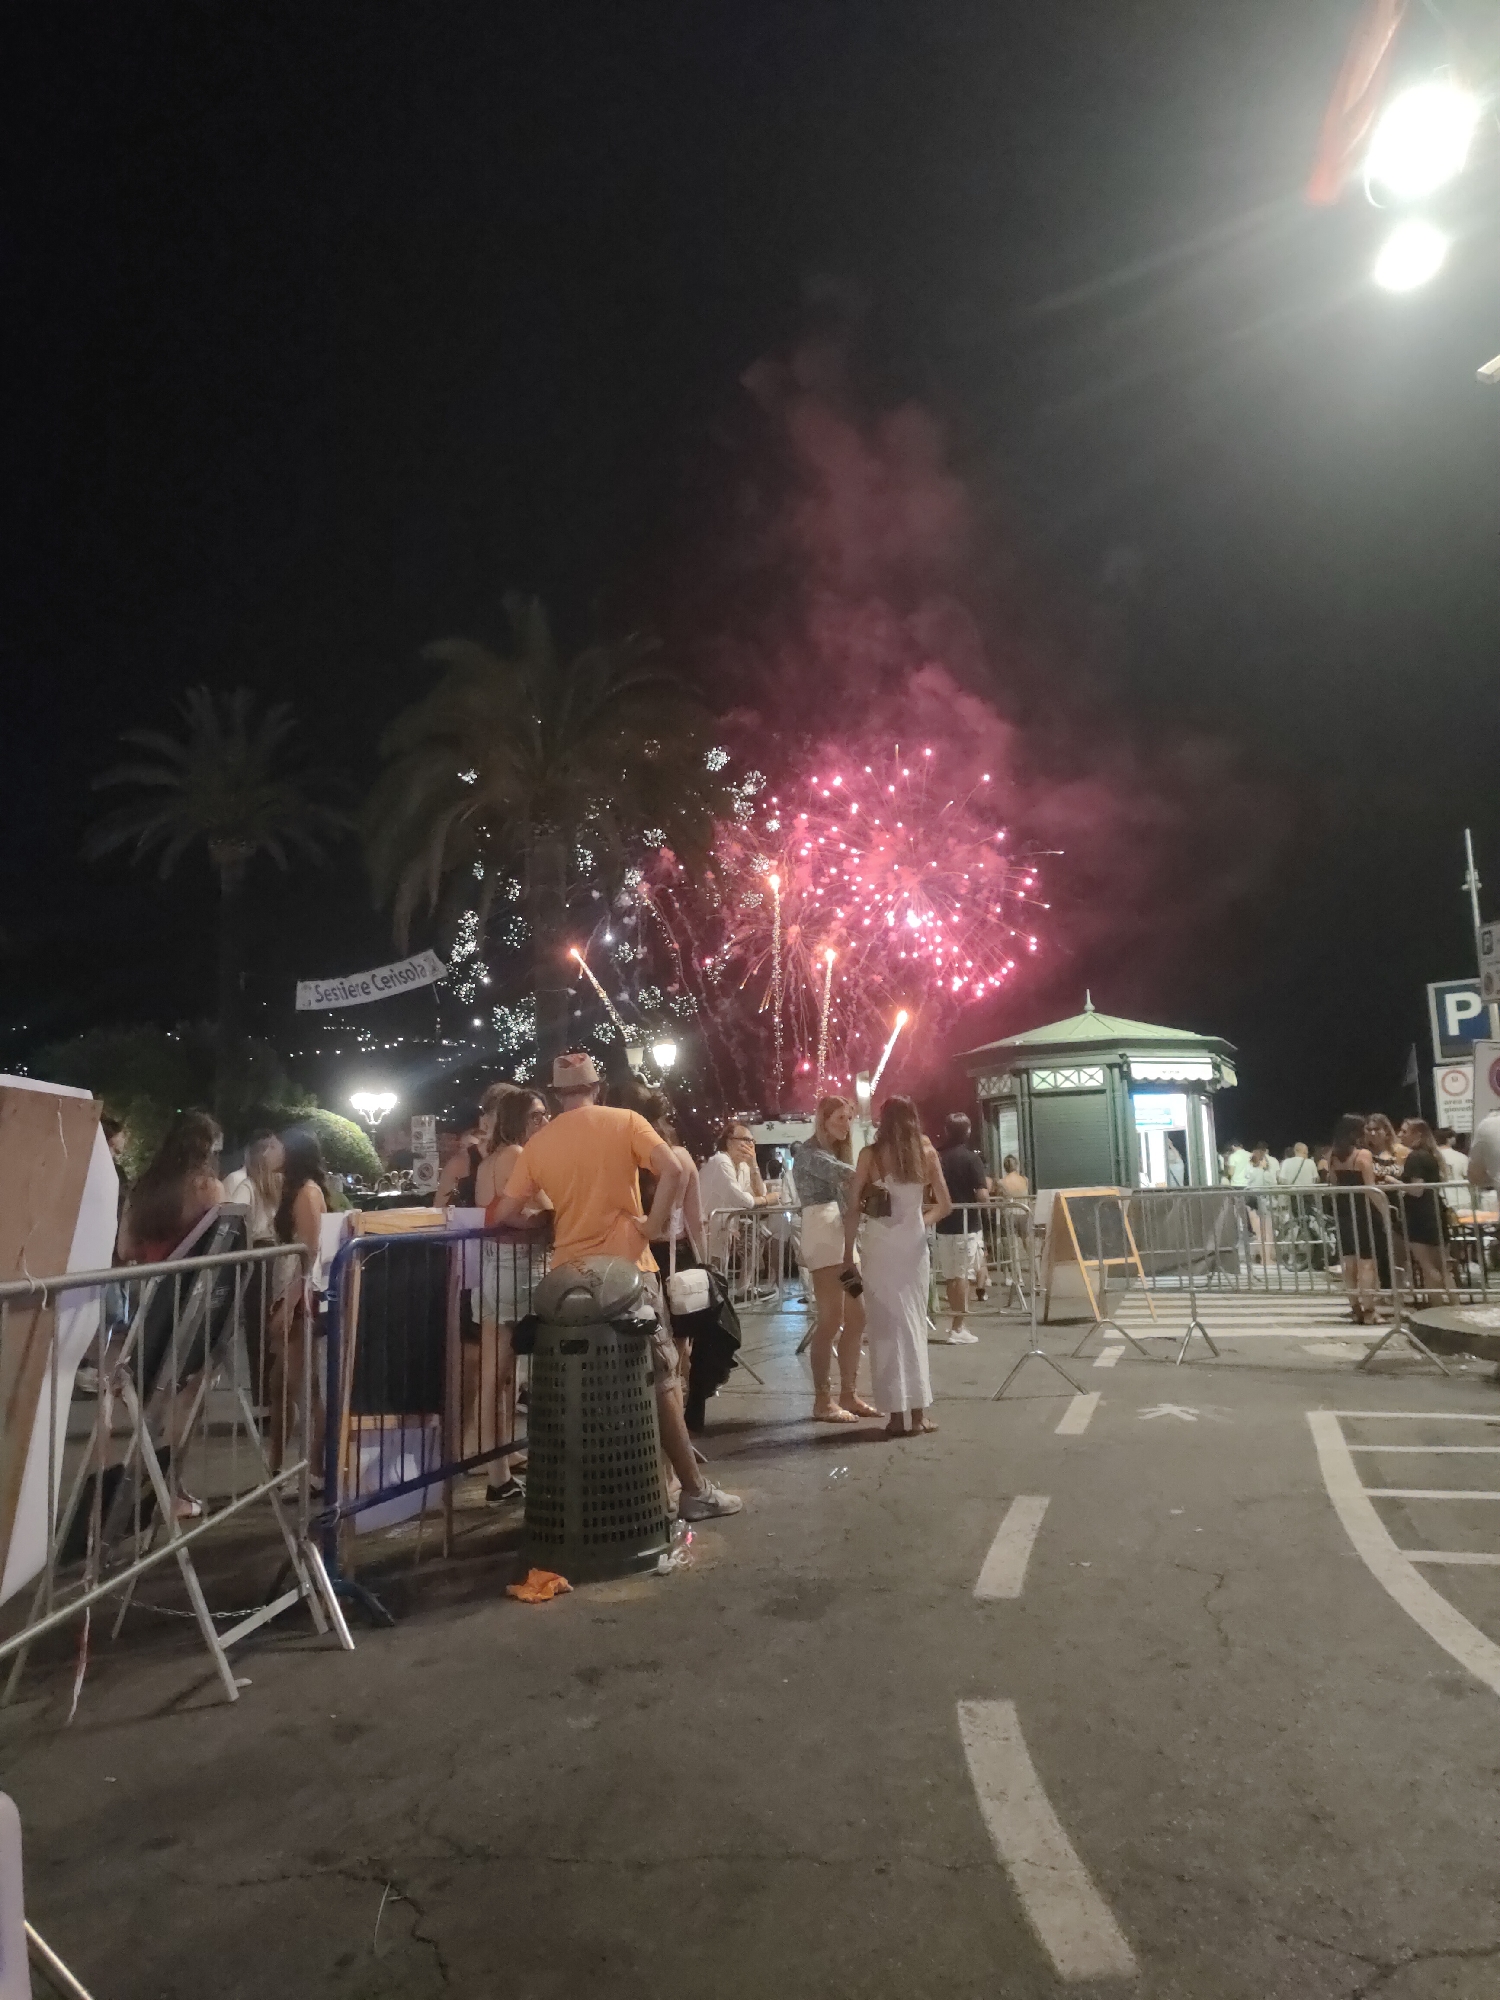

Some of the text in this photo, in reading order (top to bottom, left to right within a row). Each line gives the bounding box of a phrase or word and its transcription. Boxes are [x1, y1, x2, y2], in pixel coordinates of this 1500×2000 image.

[314, 961, 428, 1003] Sestiere Cerisola
[1445, 991, 1482, 1036] P
